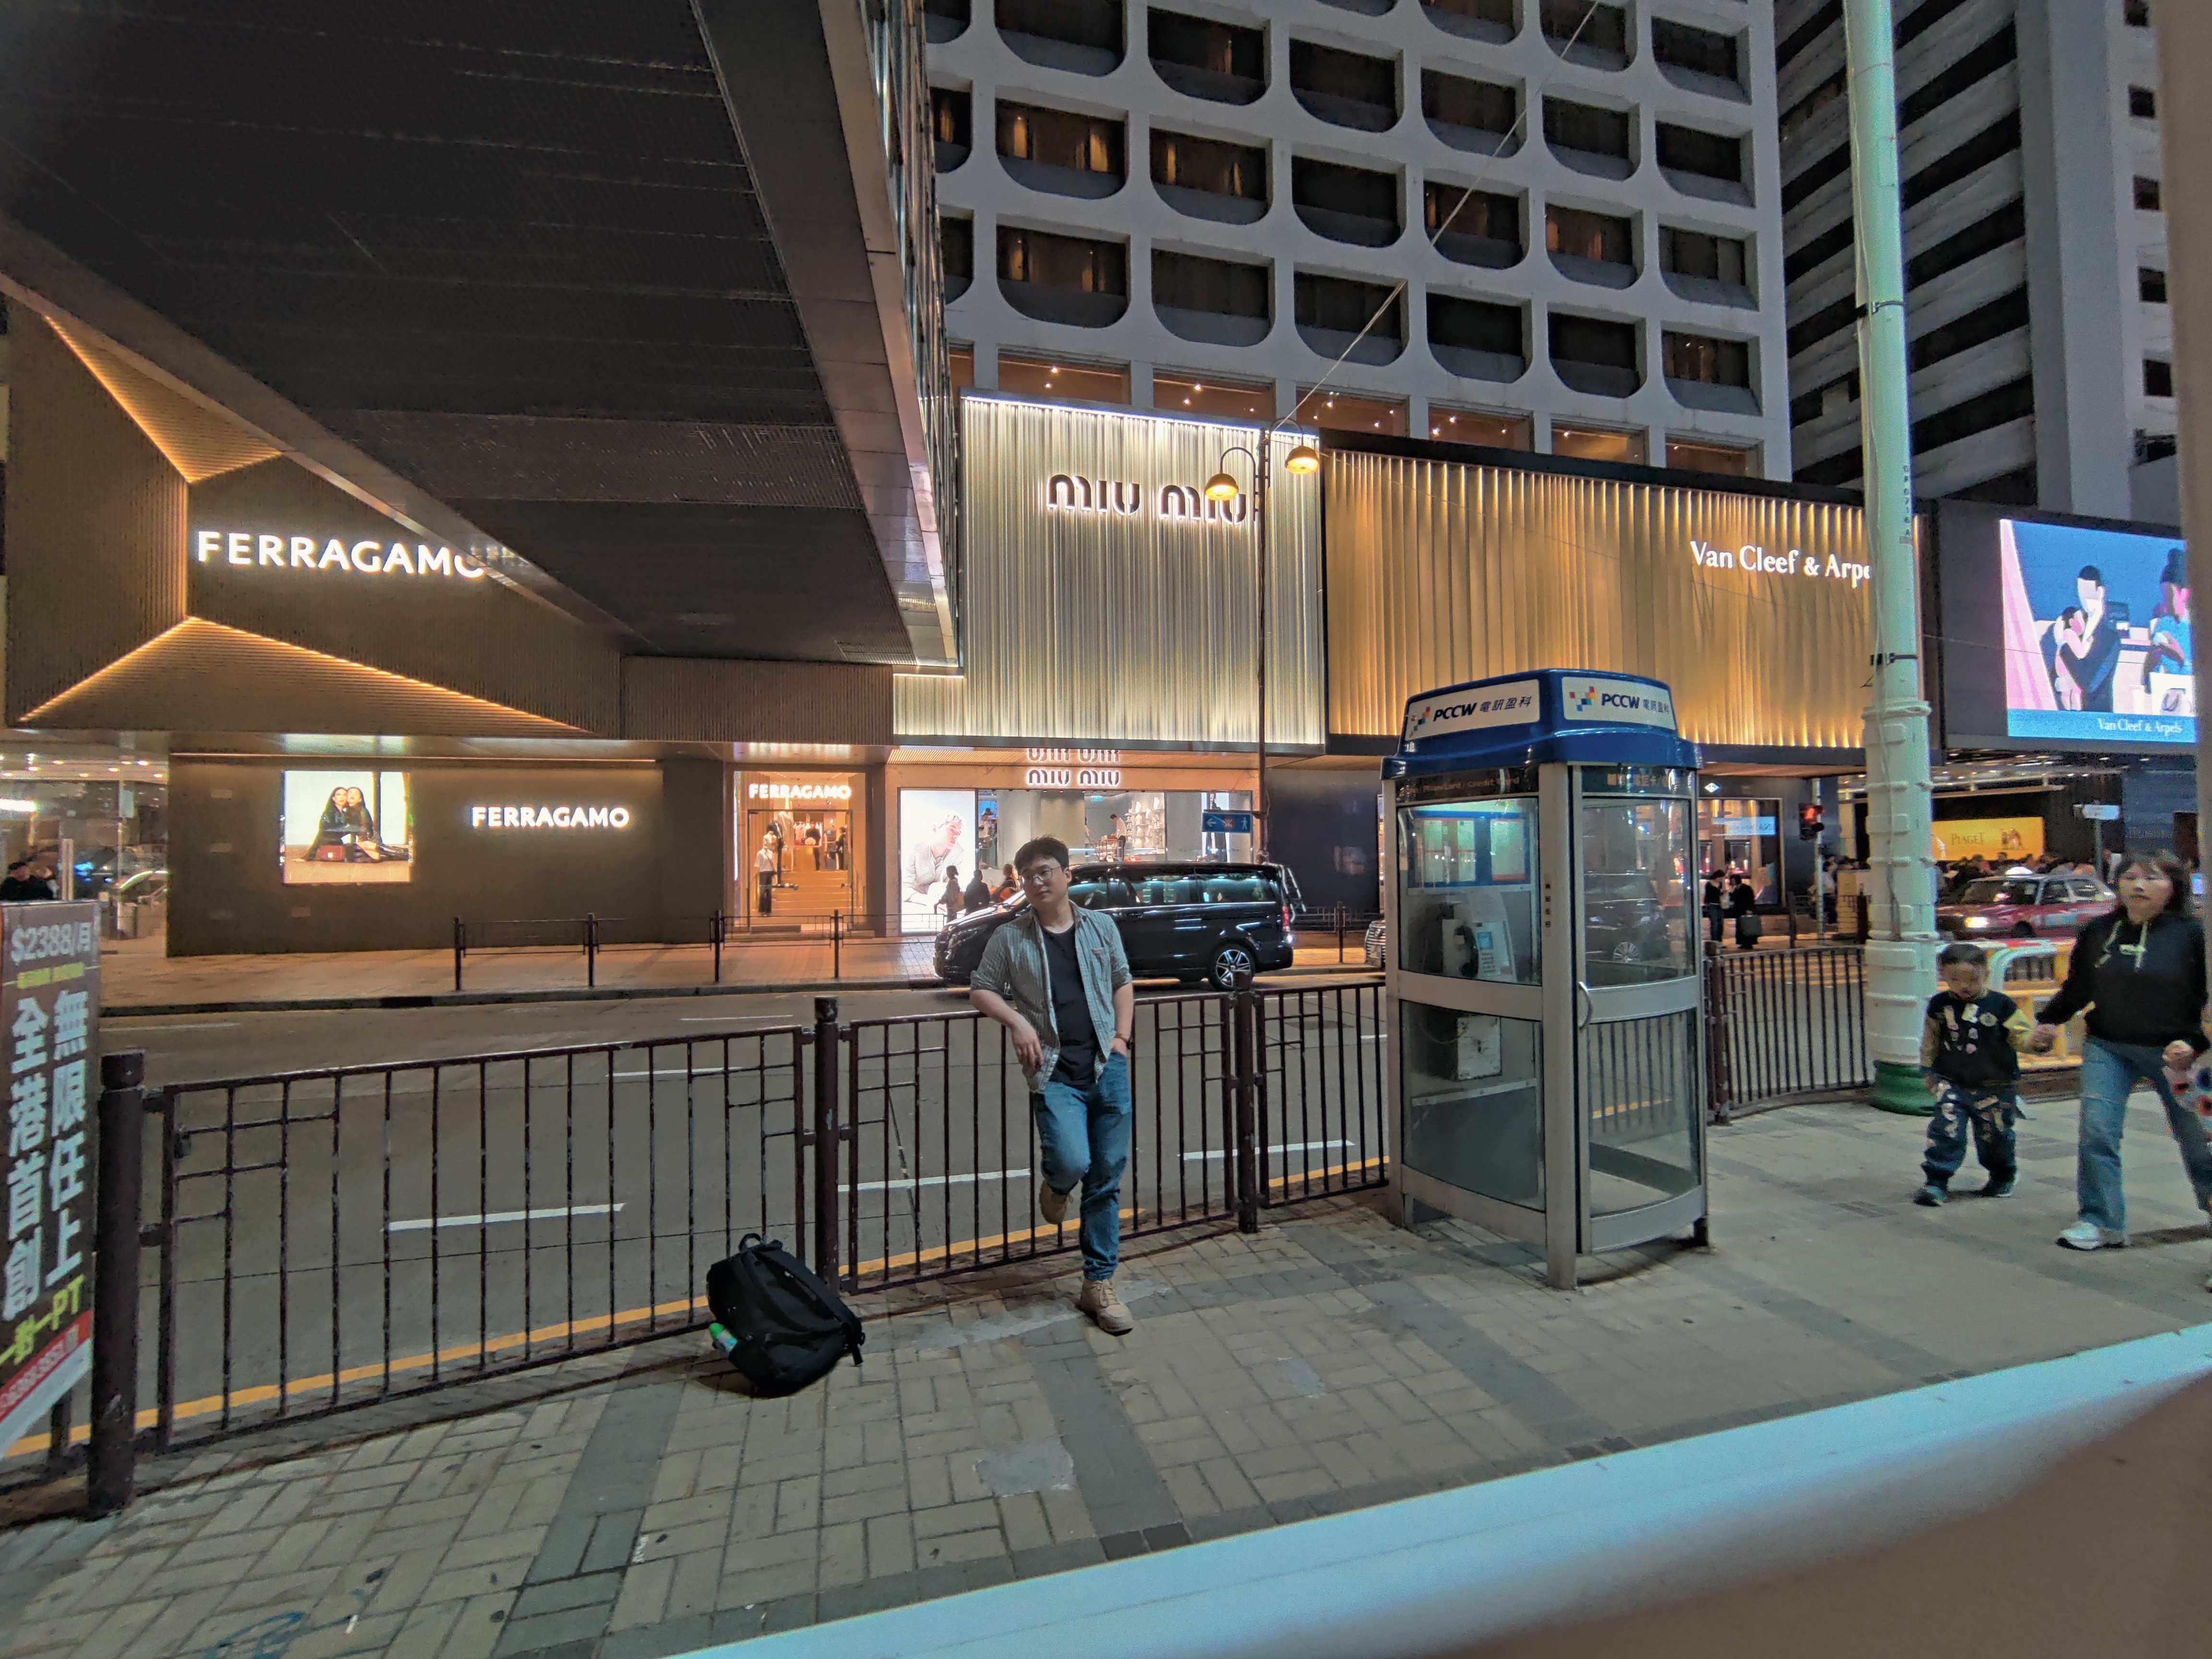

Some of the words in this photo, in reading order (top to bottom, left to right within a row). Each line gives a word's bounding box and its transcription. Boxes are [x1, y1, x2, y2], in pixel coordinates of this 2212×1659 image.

[1690, 541, 1733, 569] Van
[1739, 545, 1799, 574] Cleef
[1803, 556, 1820, 577] &
[1825, 553, 1871, 589] Arpe
[1432, 702, 1477, 721] PCCW
[1479, 696, 1532, 712] 電訊盈科
[1601, 693, 1640, 709] PCCW
[2098, 718, 2116, 730] Van
[2118, 719, 2143, 731] Cleef
[748, 783, 852, 799] FERRAGAMO
[471, 807, 629, 828] FERRAGAMO
[45, 990, 88, 1288] 無限任上
[3, 997, 48, 1320] 全港首創
